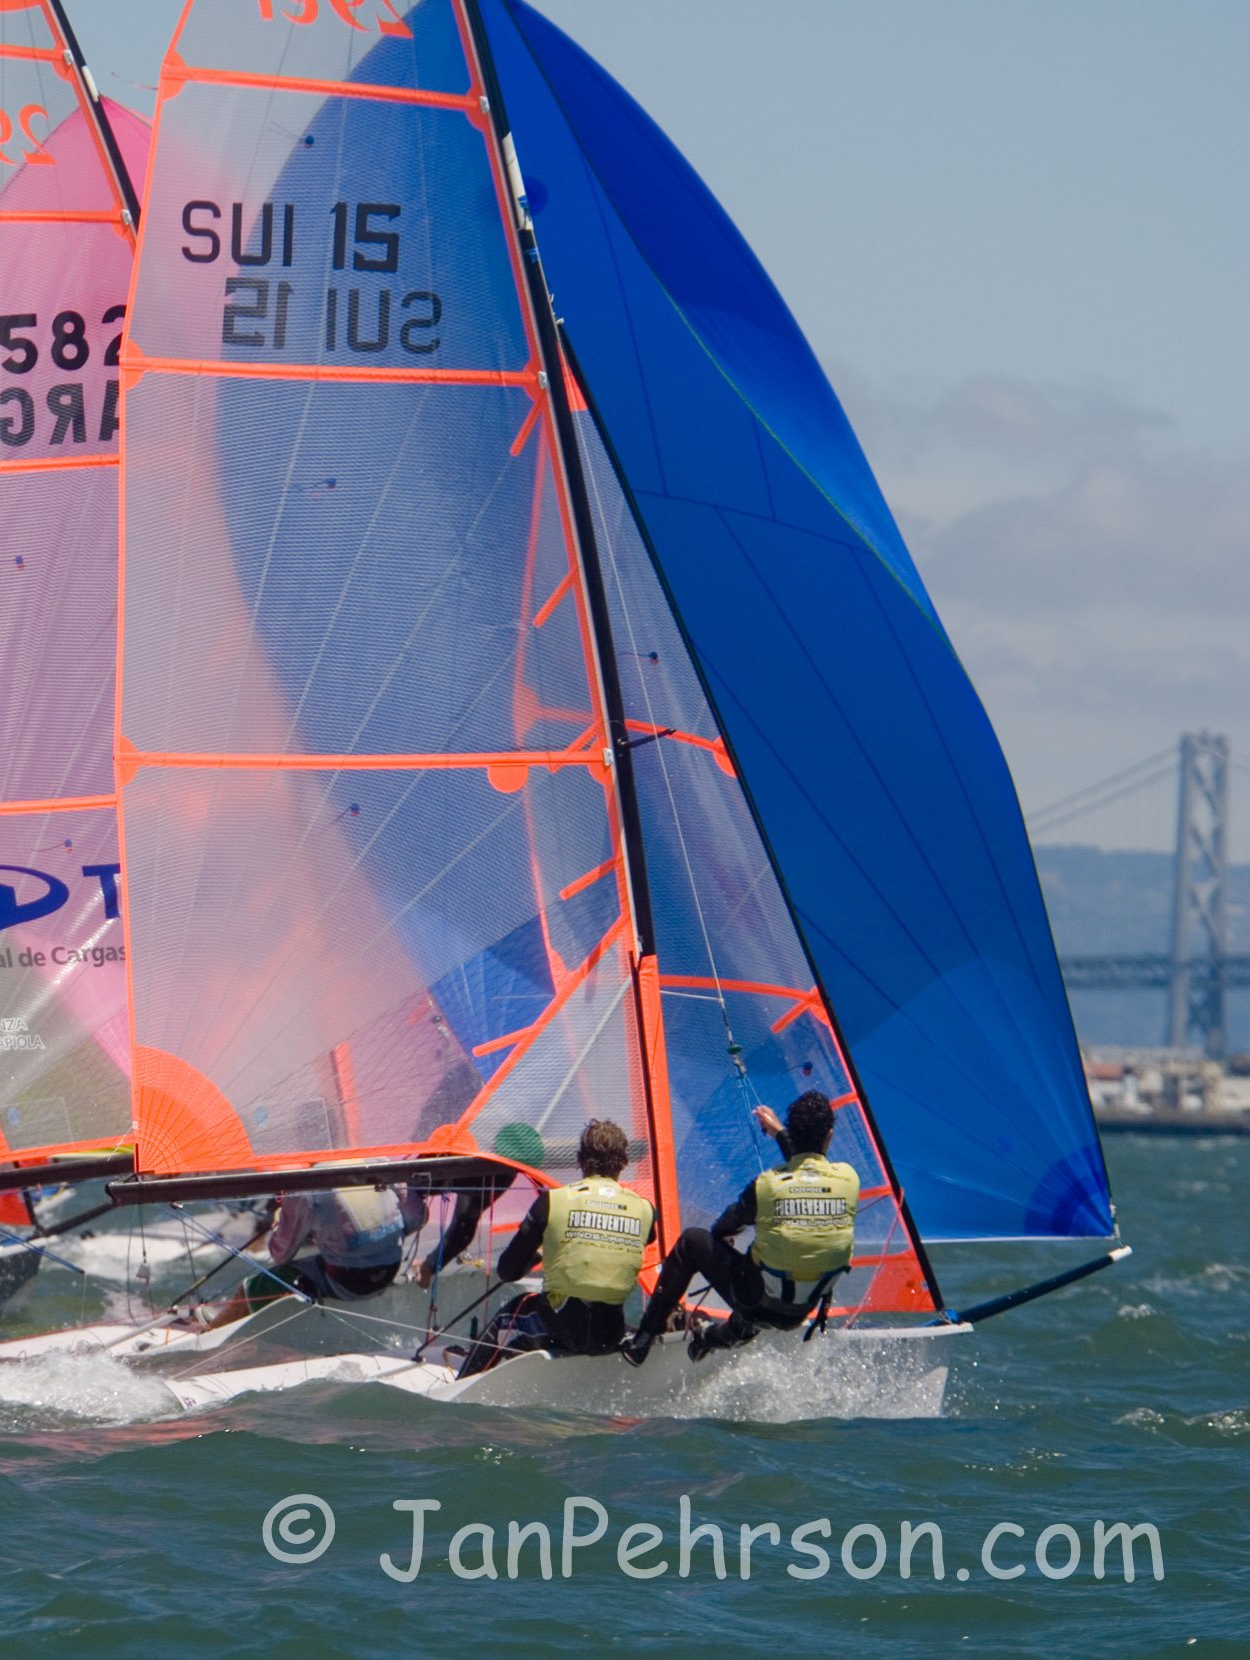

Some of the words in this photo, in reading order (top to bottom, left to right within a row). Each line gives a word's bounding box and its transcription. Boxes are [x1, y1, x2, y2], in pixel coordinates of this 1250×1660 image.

[181, 200, 294, 267] SUI
[330, 201, 402, 273] 15
[18, 946, 46, 967] de
[51, 945, 126, 967] Cargas
[568, 1210, 641, 1237] FUERTEVENTURA
